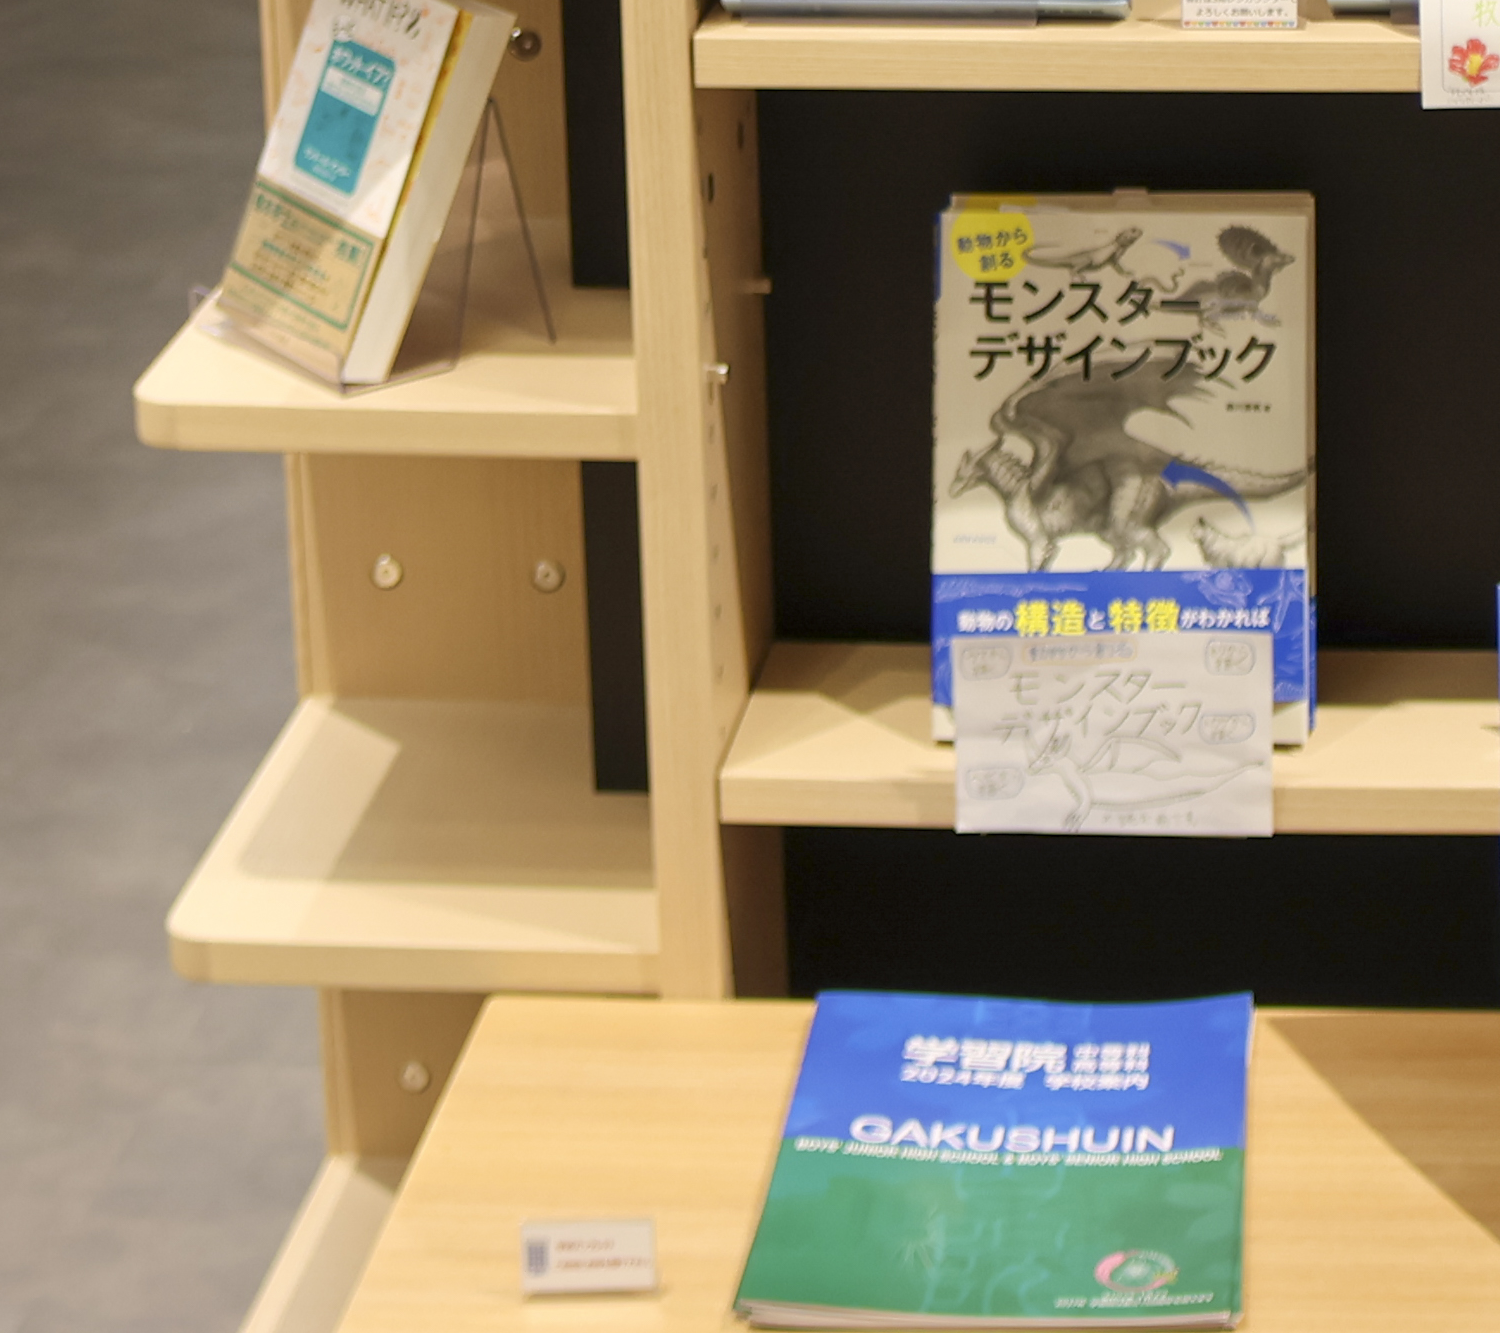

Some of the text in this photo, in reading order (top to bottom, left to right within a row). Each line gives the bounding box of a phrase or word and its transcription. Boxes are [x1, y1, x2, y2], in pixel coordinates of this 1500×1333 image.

[956, 226, 1029, 254] 動物から
[978, 251, 1015, 272] 創る
[969, 281, 1201, 325] モンスター
[969, 332, 1278, 383] デザインブック
[1008, 670, 1187, 706] モンスター
[902, 1035, 1068, 1074] 学習院
[849, 1114, 1175, 1154] GAKUSHUIN
